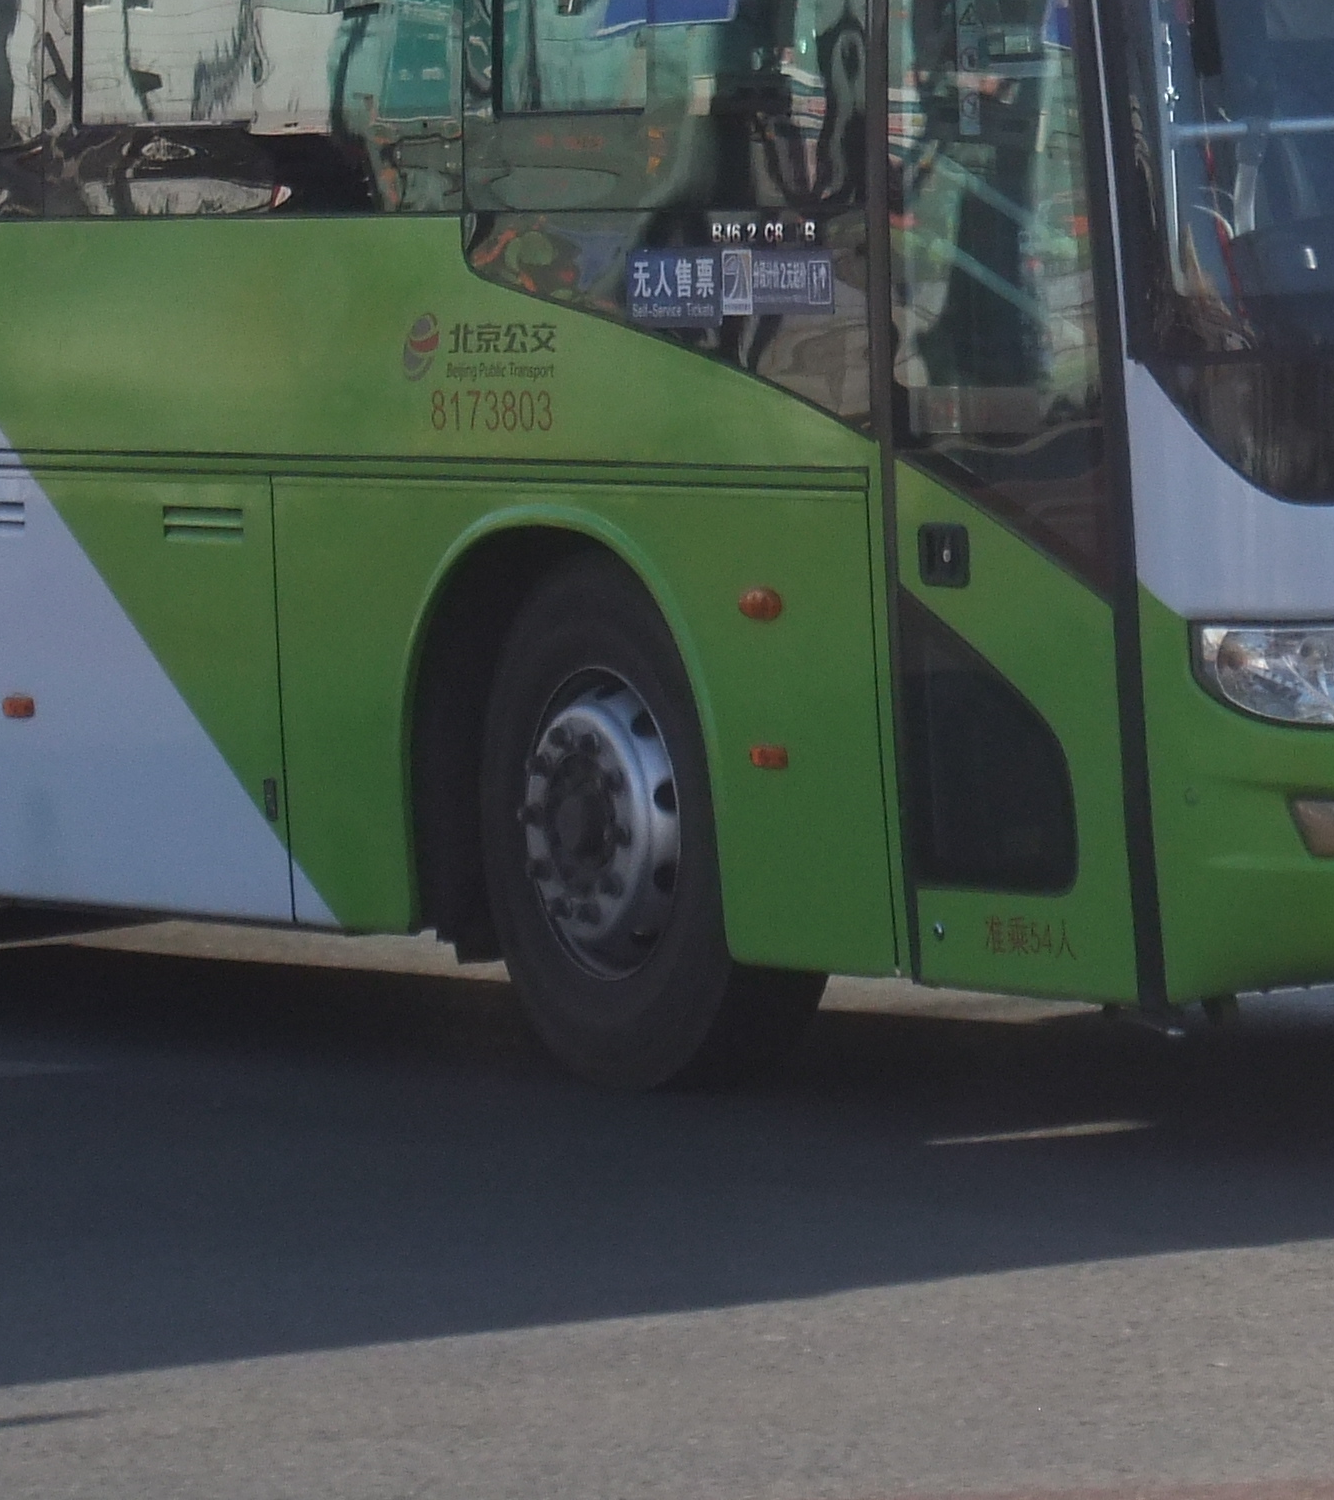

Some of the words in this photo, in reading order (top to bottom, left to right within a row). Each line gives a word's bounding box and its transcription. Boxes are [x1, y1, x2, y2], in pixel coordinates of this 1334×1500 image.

[633, 258, 715, 298] 无人售票
[448, 322, 557, 354] 北京公交
[446, 362, 477, 382] Beijing
[479, 362, 506, 378] Public
[509, 362, 555, 382] Transport
[431, 389, 553, 431] 8173803
